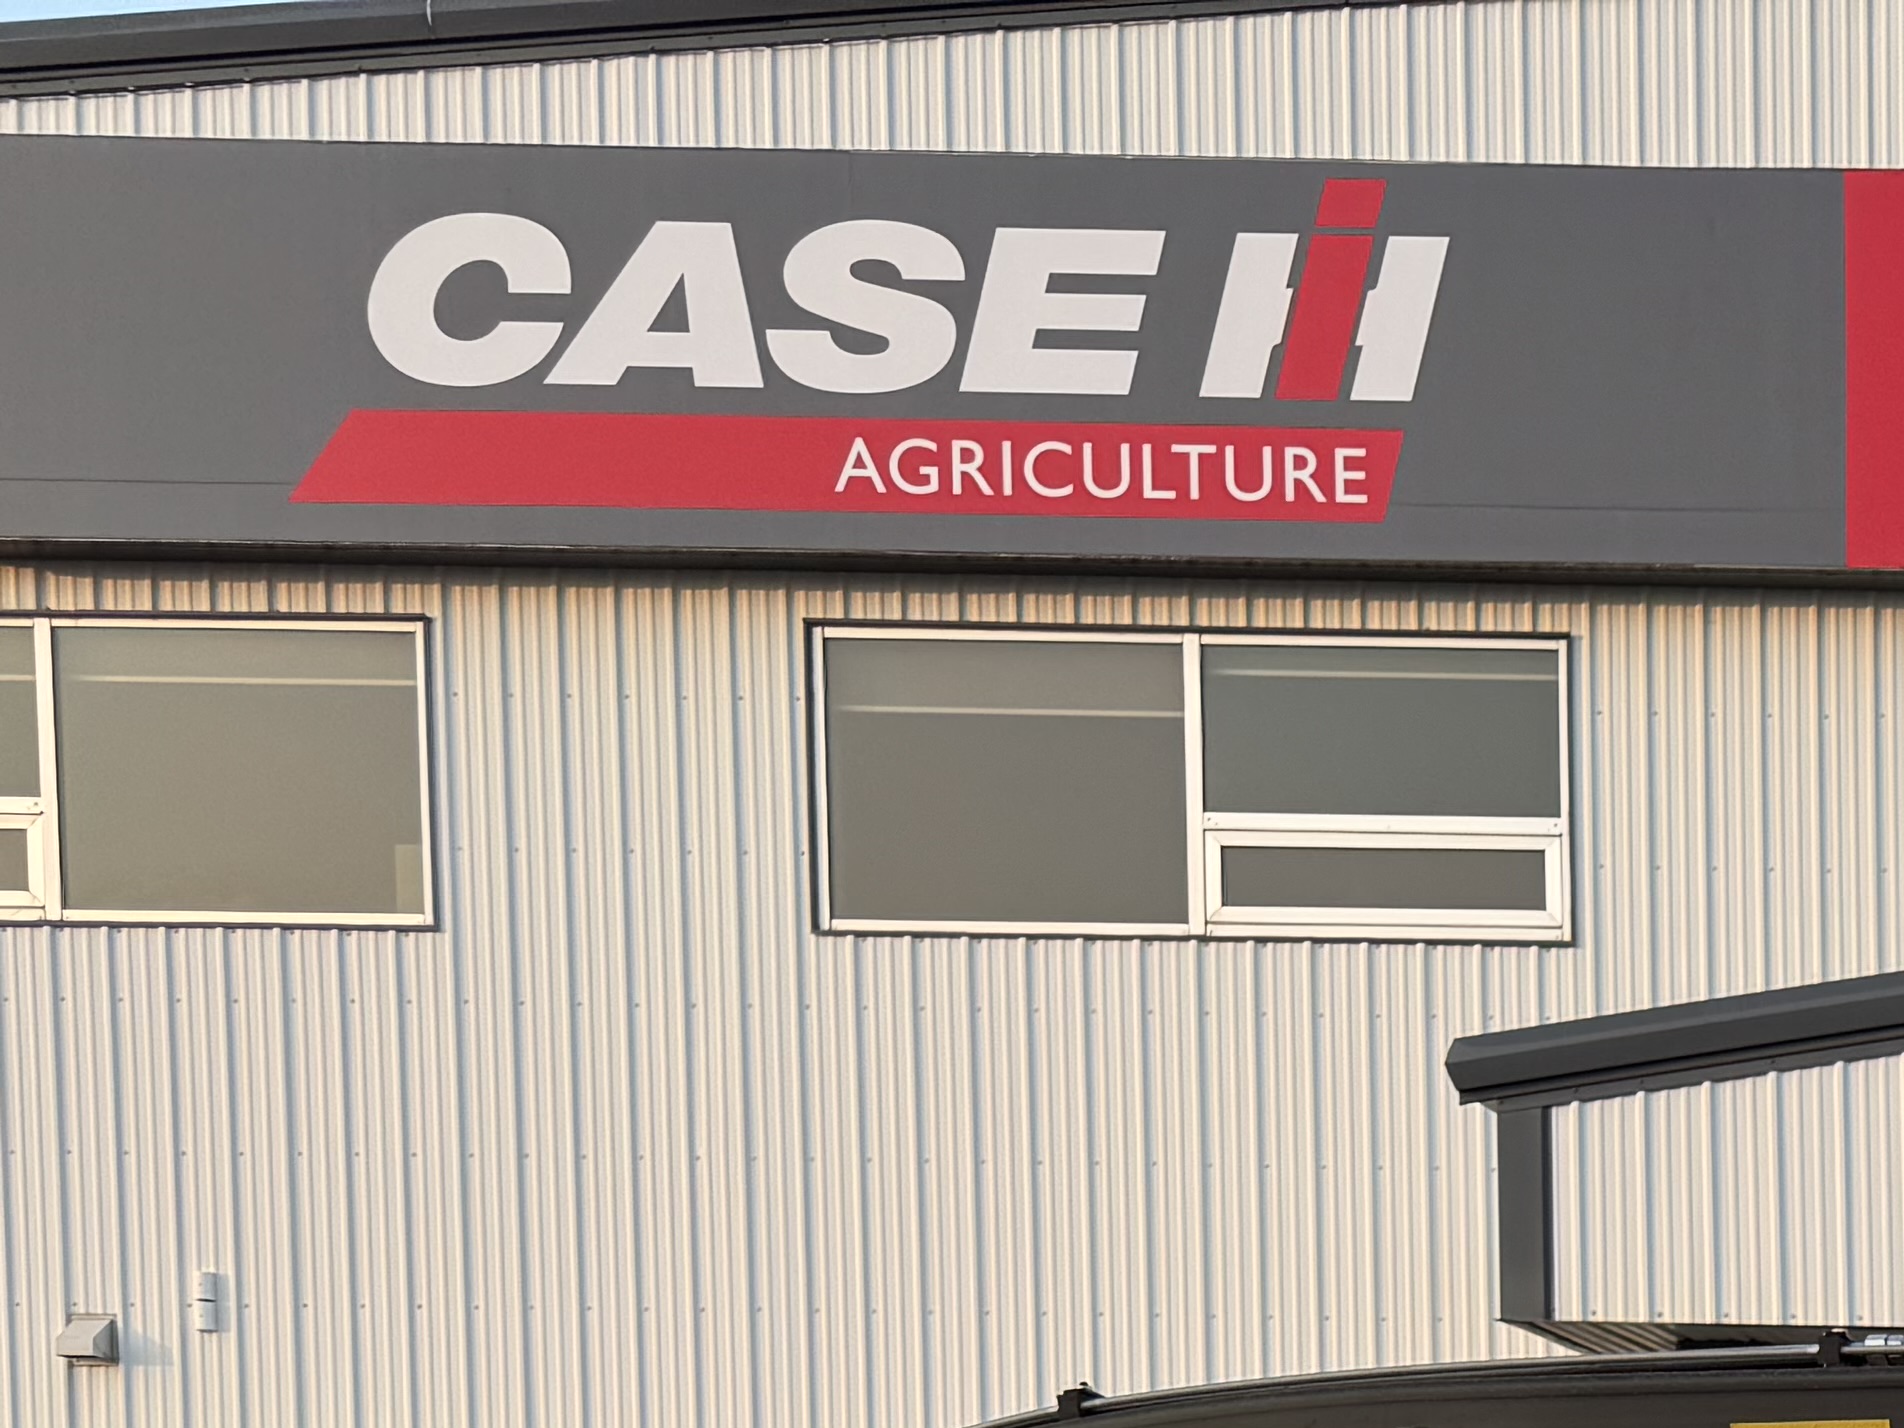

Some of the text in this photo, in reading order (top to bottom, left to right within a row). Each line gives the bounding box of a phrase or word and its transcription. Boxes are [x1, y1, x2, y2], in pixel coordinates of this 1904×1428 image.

[366, 177, 1450, 403] CASE IH
[834, 432, 1369, 504] AGRICULTURE
